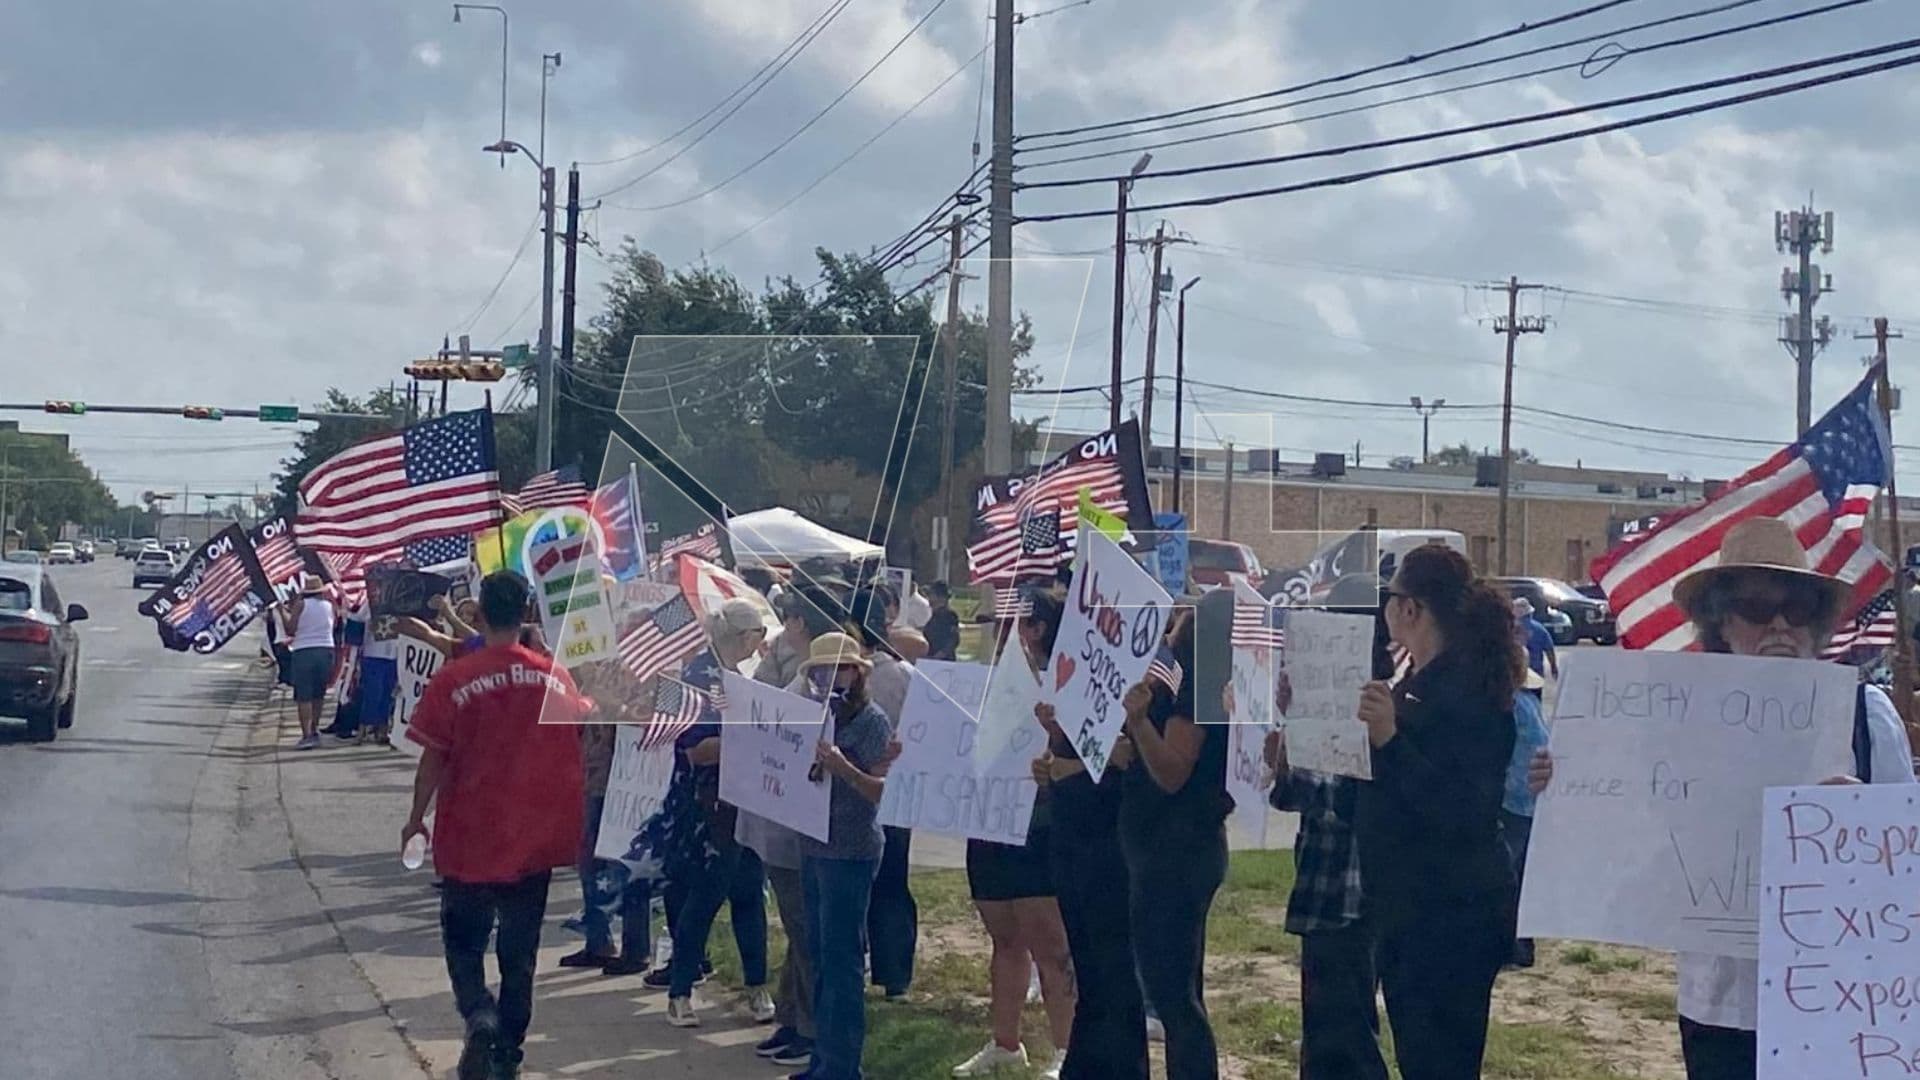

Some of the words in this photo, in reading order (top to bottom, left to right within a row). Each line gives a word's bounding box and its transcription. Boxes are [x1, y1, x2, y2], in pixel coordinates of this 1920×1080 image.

[1551, 664, 1693, 724] Liberty
[1719, 679, 1818, 734] and
[1650, 761, 1701, 801] for
